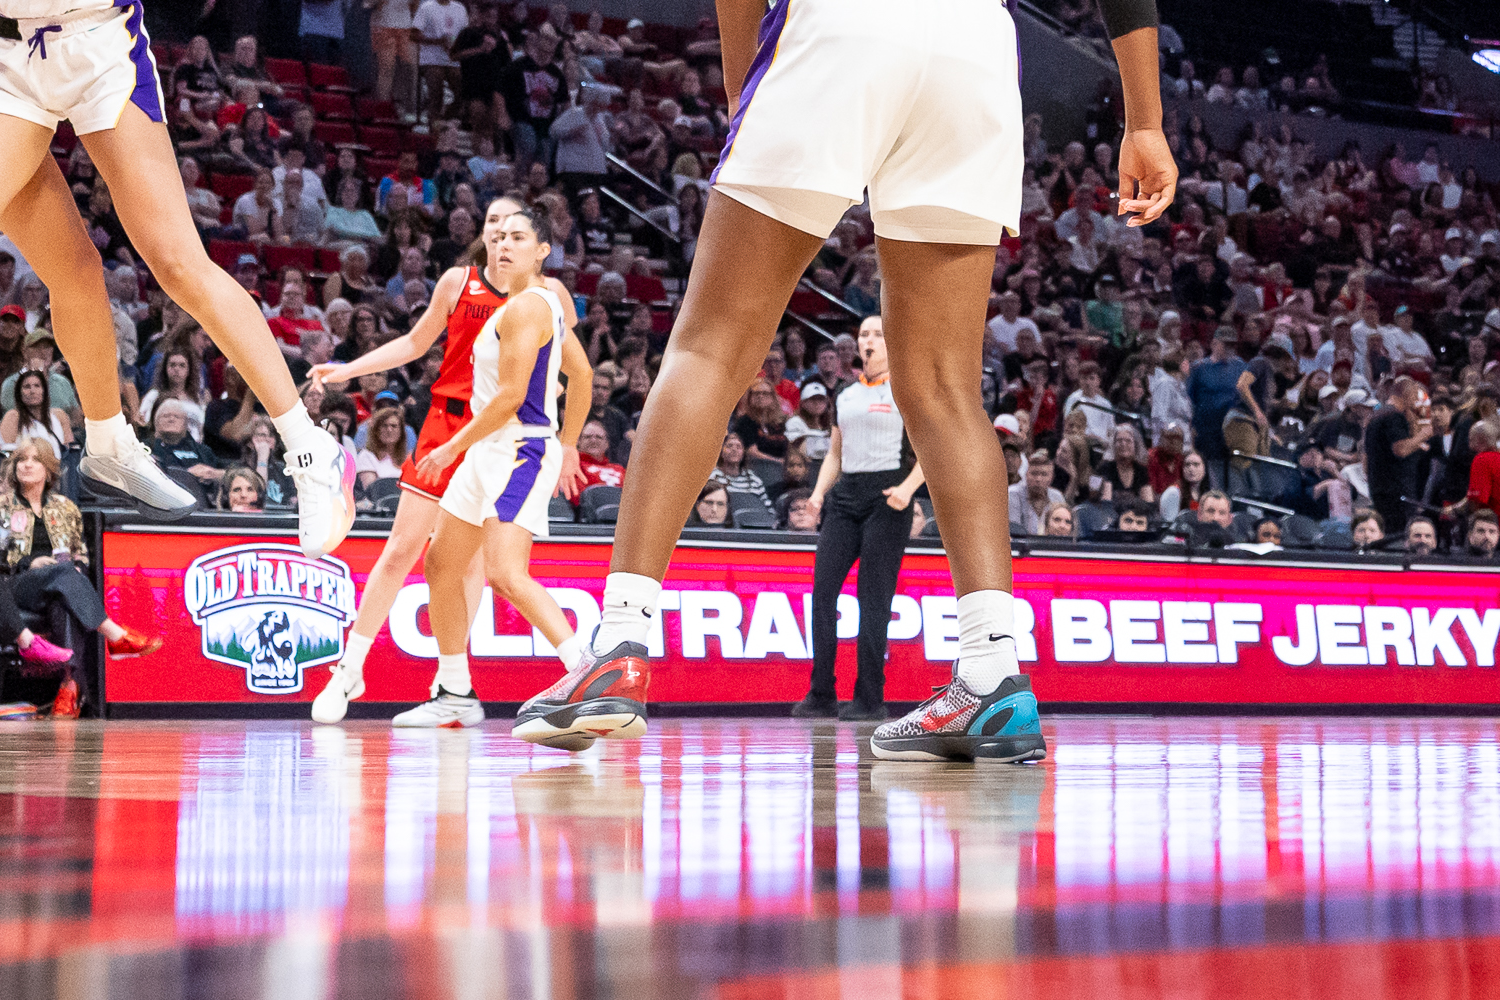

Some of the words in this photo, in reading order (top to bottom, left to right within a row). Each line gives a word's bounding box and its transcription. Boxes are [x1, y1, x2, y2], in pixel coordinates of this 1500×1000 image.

[186, 564, 238, 612] OLD
[237, 552, 352, 616] TRAPPER
[1051, 598, 1263, 664] BEEF
[1272, 603, 1500, 667] JERKY
